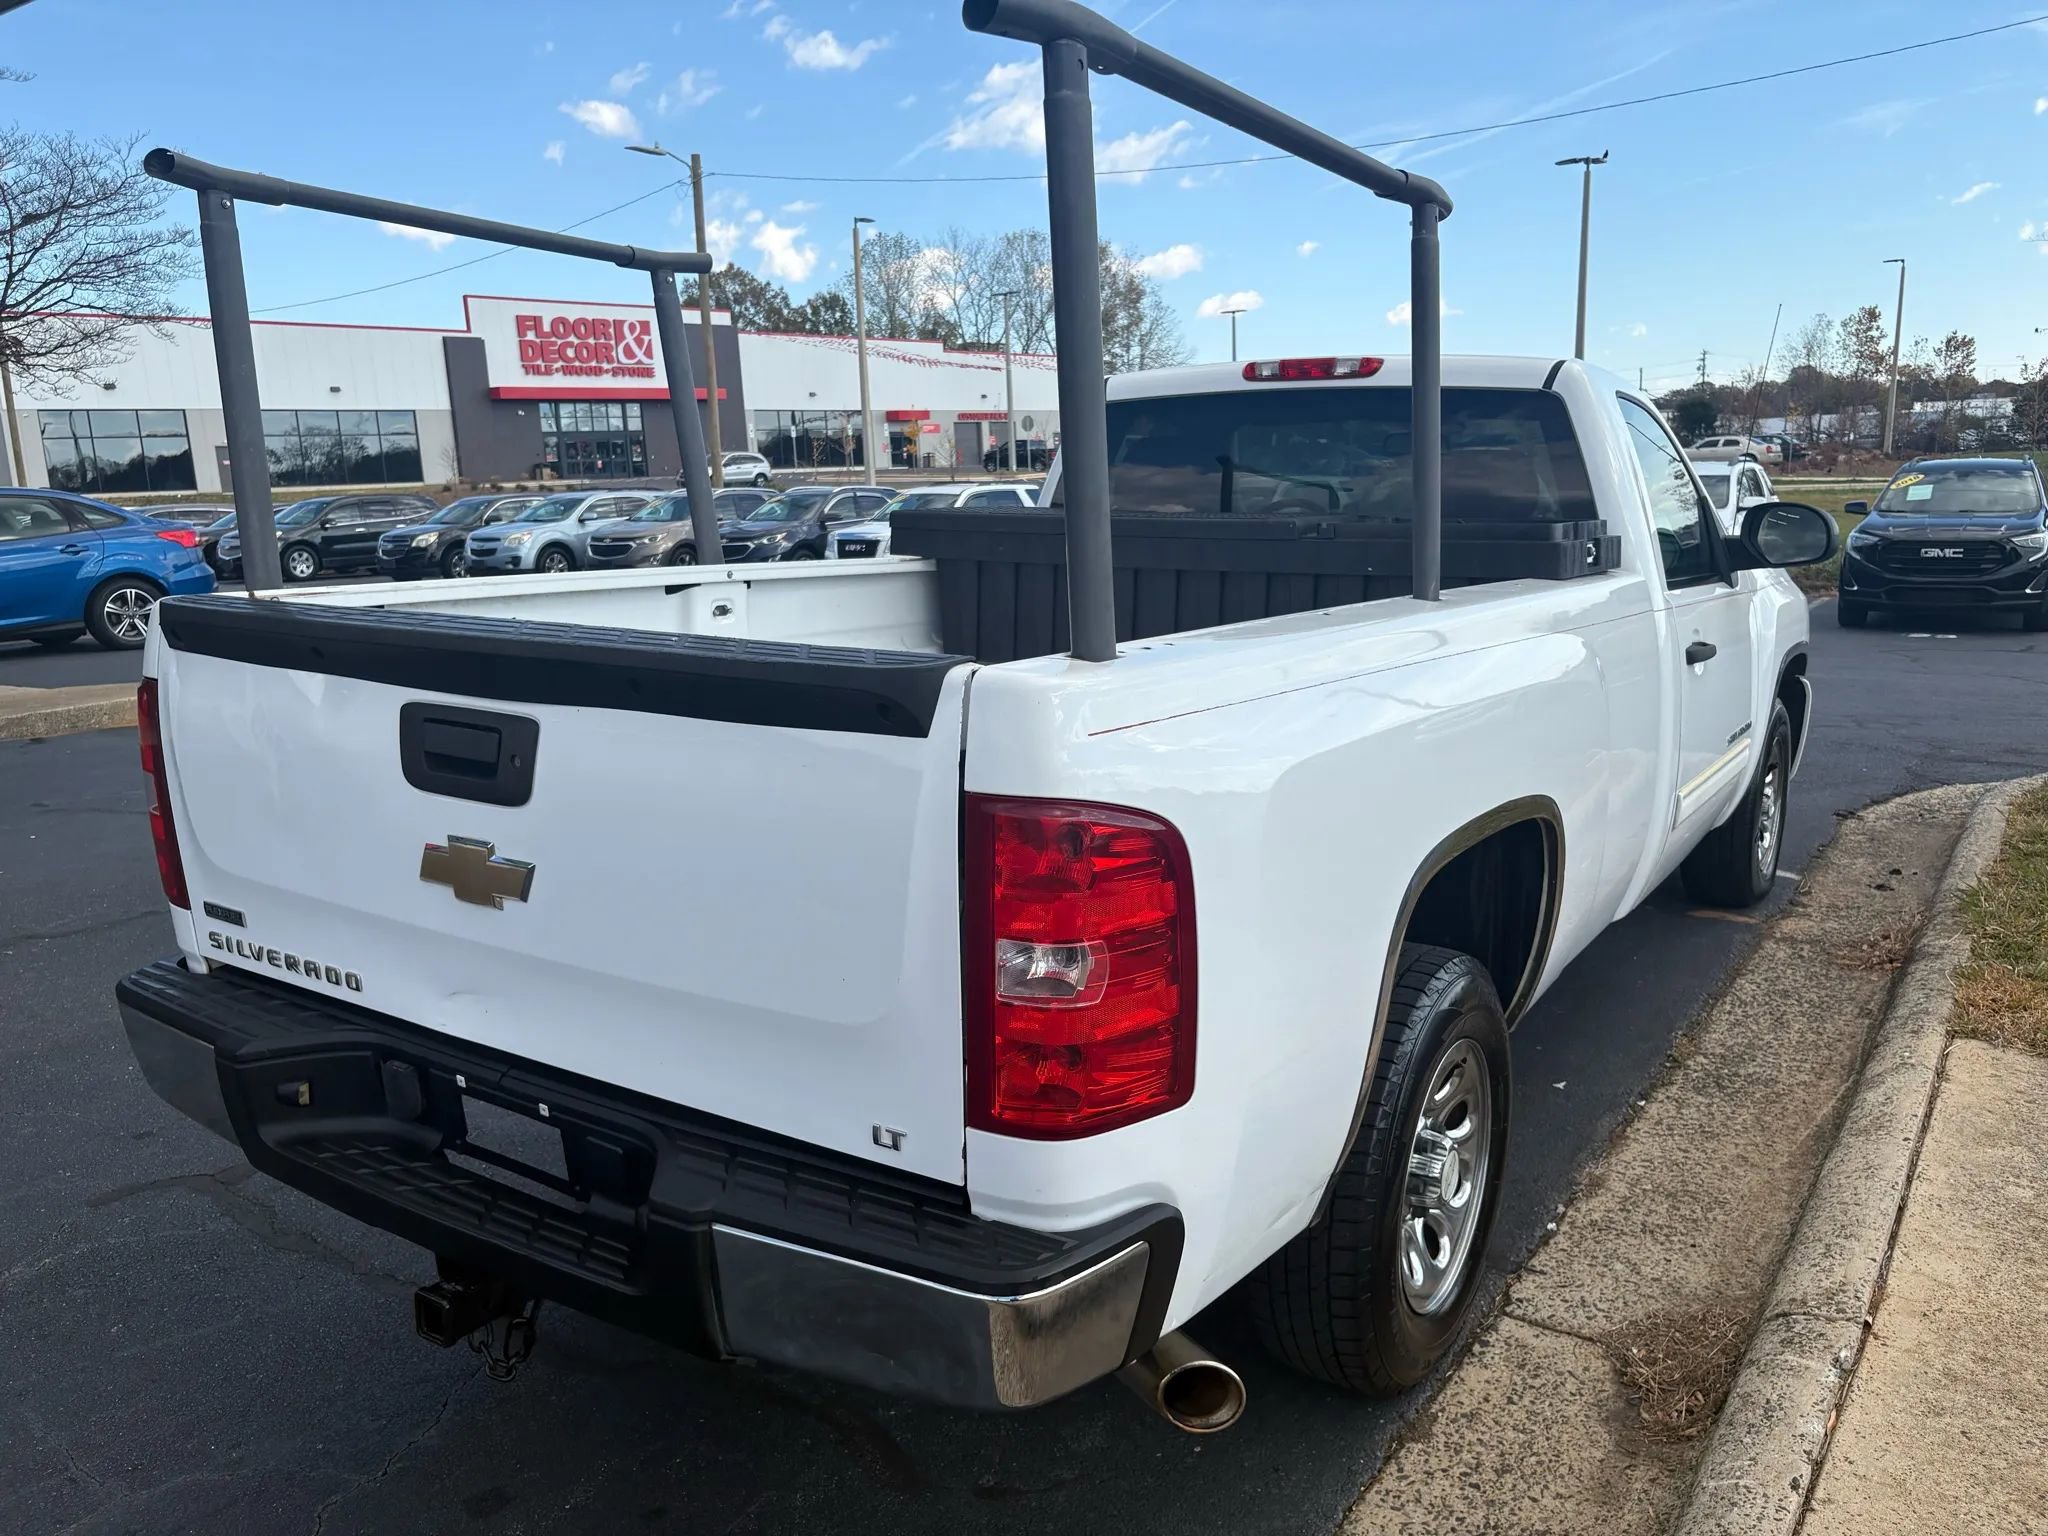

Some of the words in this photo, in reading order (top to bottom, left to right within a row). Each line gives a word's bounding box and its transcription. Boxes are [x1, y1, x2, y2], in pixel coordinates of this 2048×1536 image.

[516, 315, 613, 340] FLOOR
[614, 319, 653, 365] &
[519, 340, 616, 364] DECOR
[1920, 548, 1964, 558] GMC
[208, 931, 363, 992] SILVERADO
[872, 1123, 907, 1151] LT
